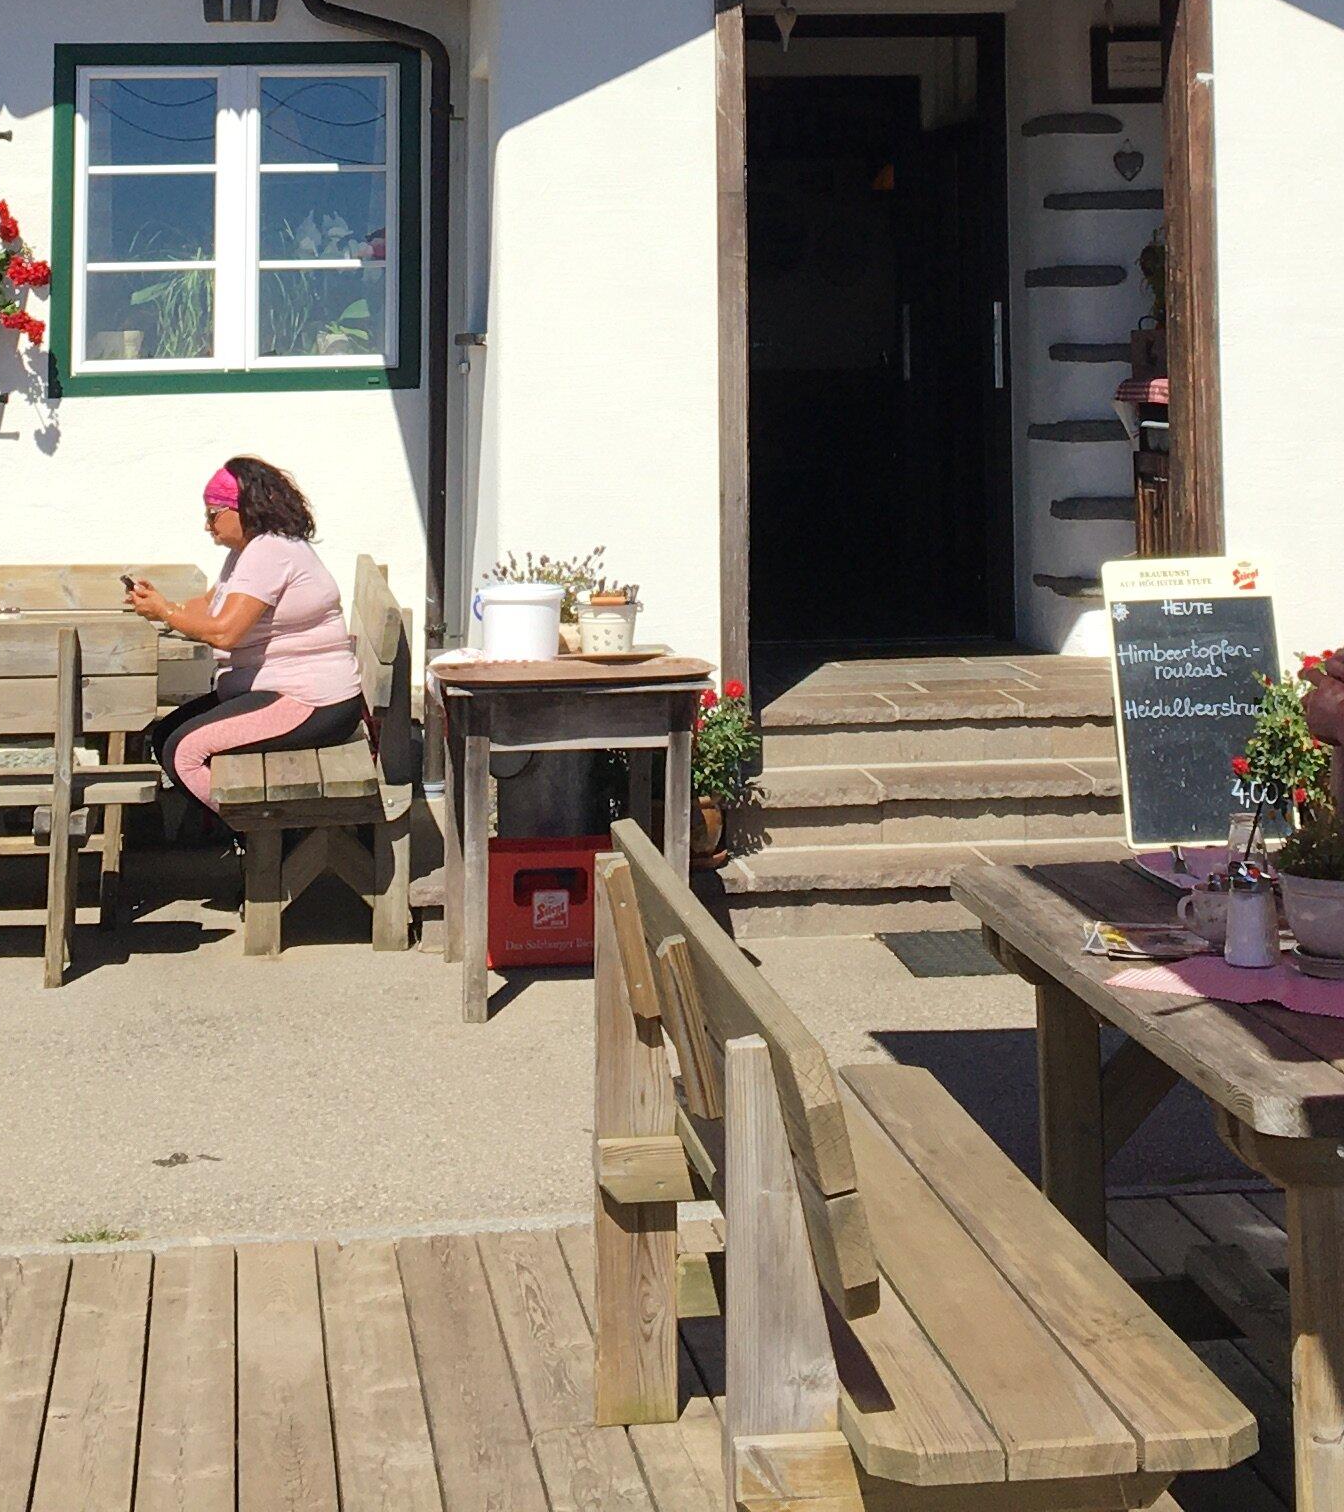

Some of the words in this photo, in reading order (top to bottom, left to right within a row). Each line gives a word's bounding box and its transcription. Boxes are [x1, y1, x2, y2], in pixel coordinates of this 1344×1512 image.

[1139, 569, 1191, 579] BRAUKUNST
[1161, 599, 1214, 616] HEUTE
[1117, 638, 1261, 666] Himbeertopfen-
[1154, 662, 1228, 680] roulade
